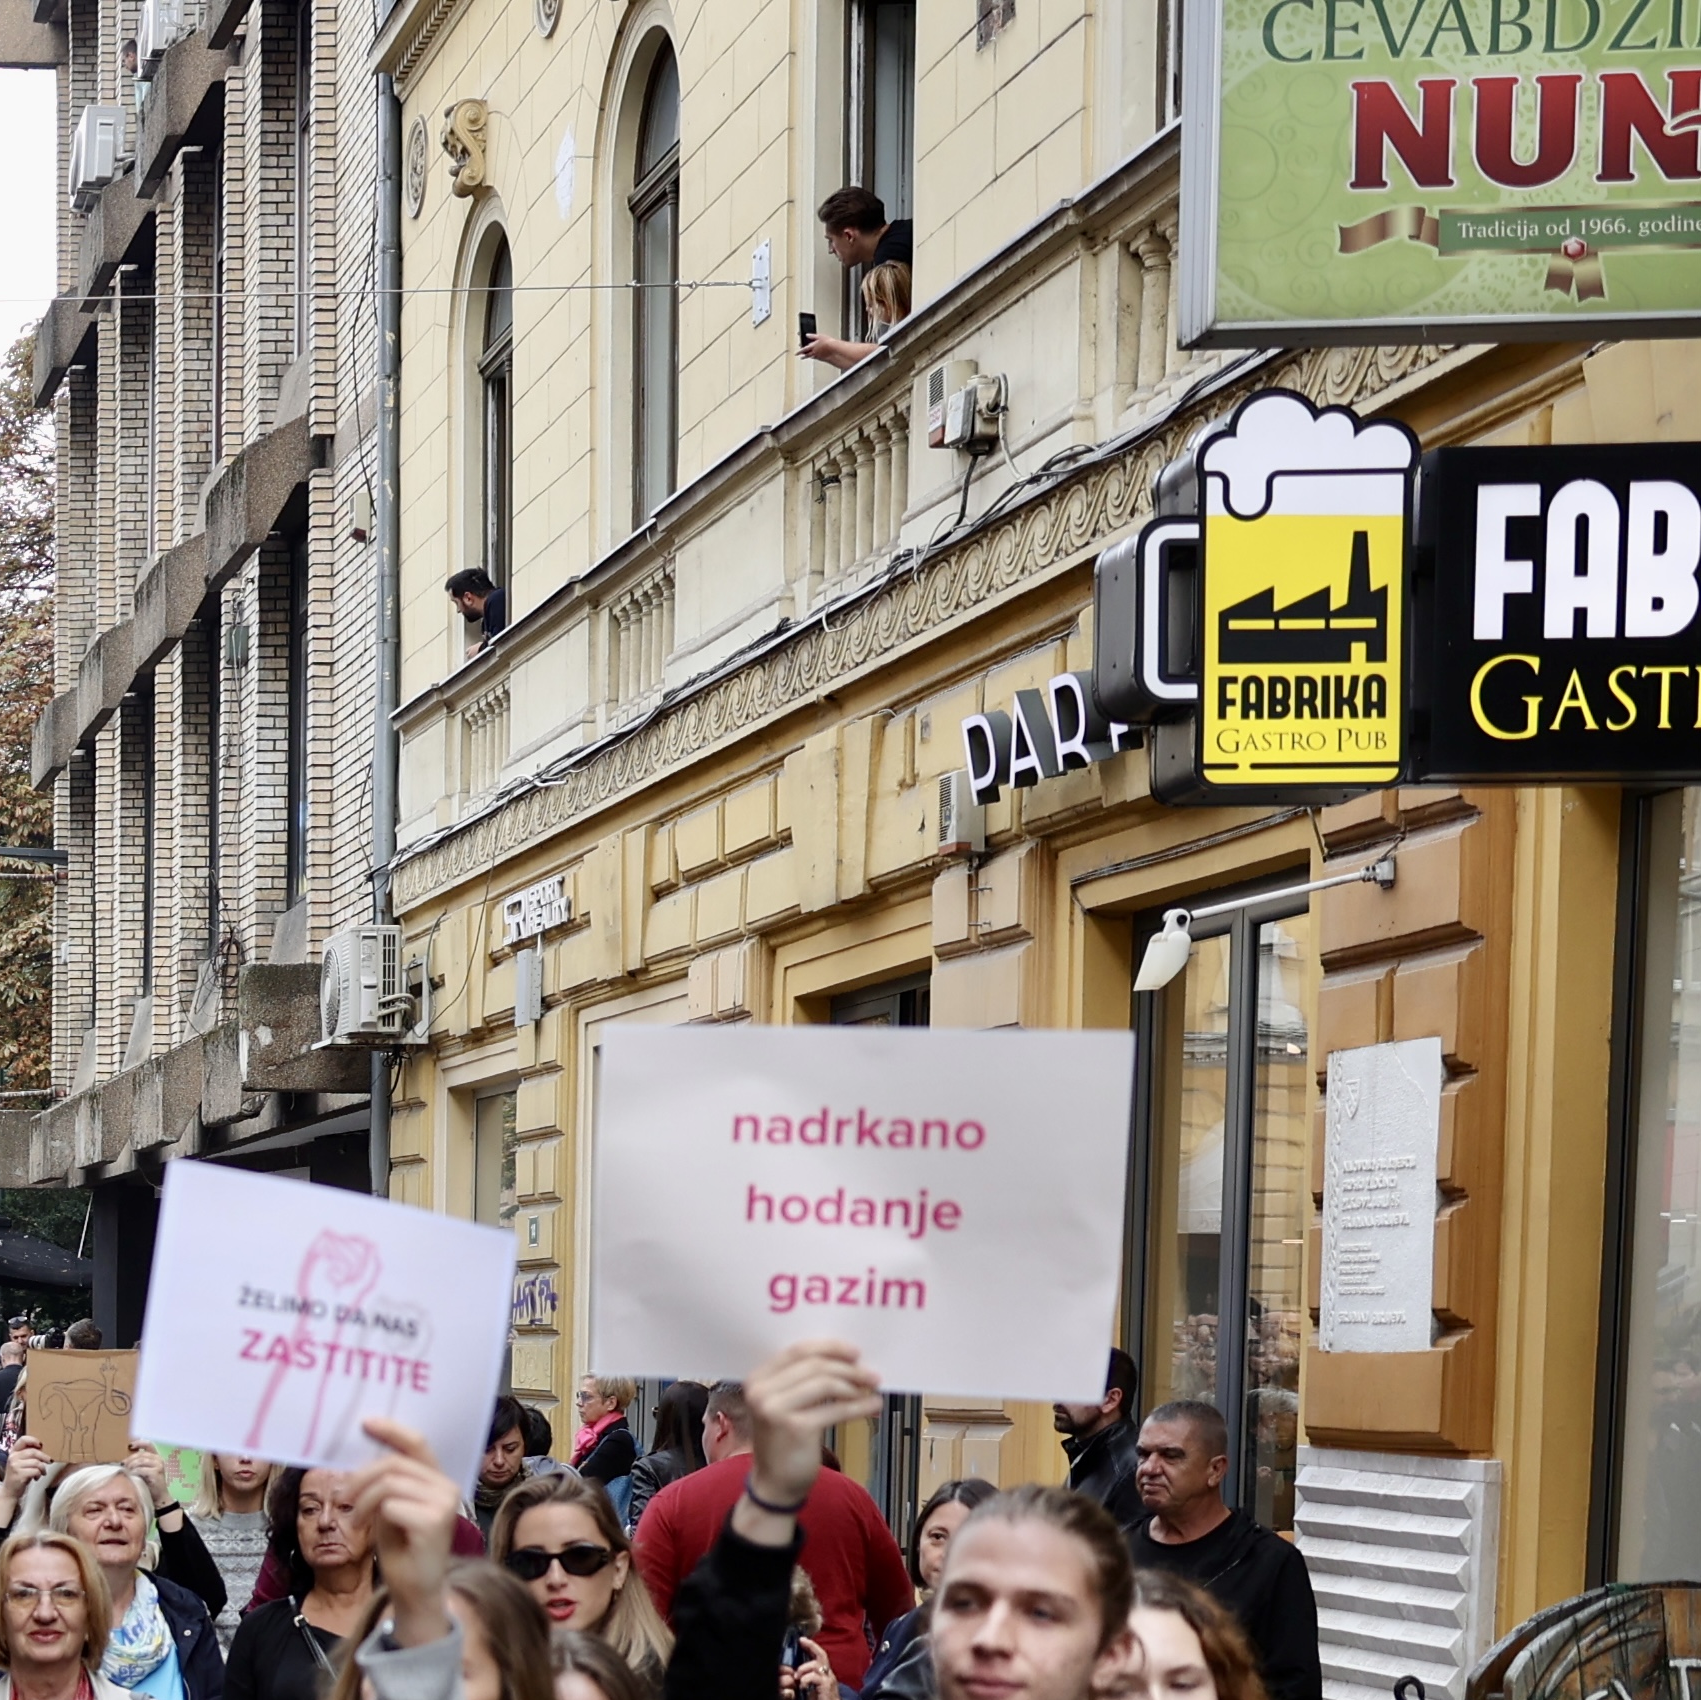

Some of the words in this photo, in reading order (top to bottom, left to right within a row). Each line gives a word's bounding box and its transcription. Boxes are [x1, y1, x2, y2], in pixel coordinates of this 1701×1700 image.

[1457, 219, 1540, 241] Tradicija
[1546, 218, 1571, 236] od
[1580, 217, 1631, 235] 1966.
[1473, 478, 1701, 641] FAB
[1217, 673, 1388, 721] FABRIKA
[1469, 653, 1701, 741] GAST
[1216, 728, 1327, 755] GASTRO
[1336, 727, 1389, 754] PUB
[527, 874, 564, 910] SPORT
[529, 895, 570, 936] REALITY
[730, 1107, 987, 1151] nadrkano
[745, 1183, 964, 1240] hodanje
[236, 1284, 330, 1321] ŽELIMO
[334, 1301, 368, 1328] DA
[368, 1307, 421, 1339] NAS
[767, 1267, 928, 1314] gazim
[237, 1327, 432, 1393] ZAŠTITITE
